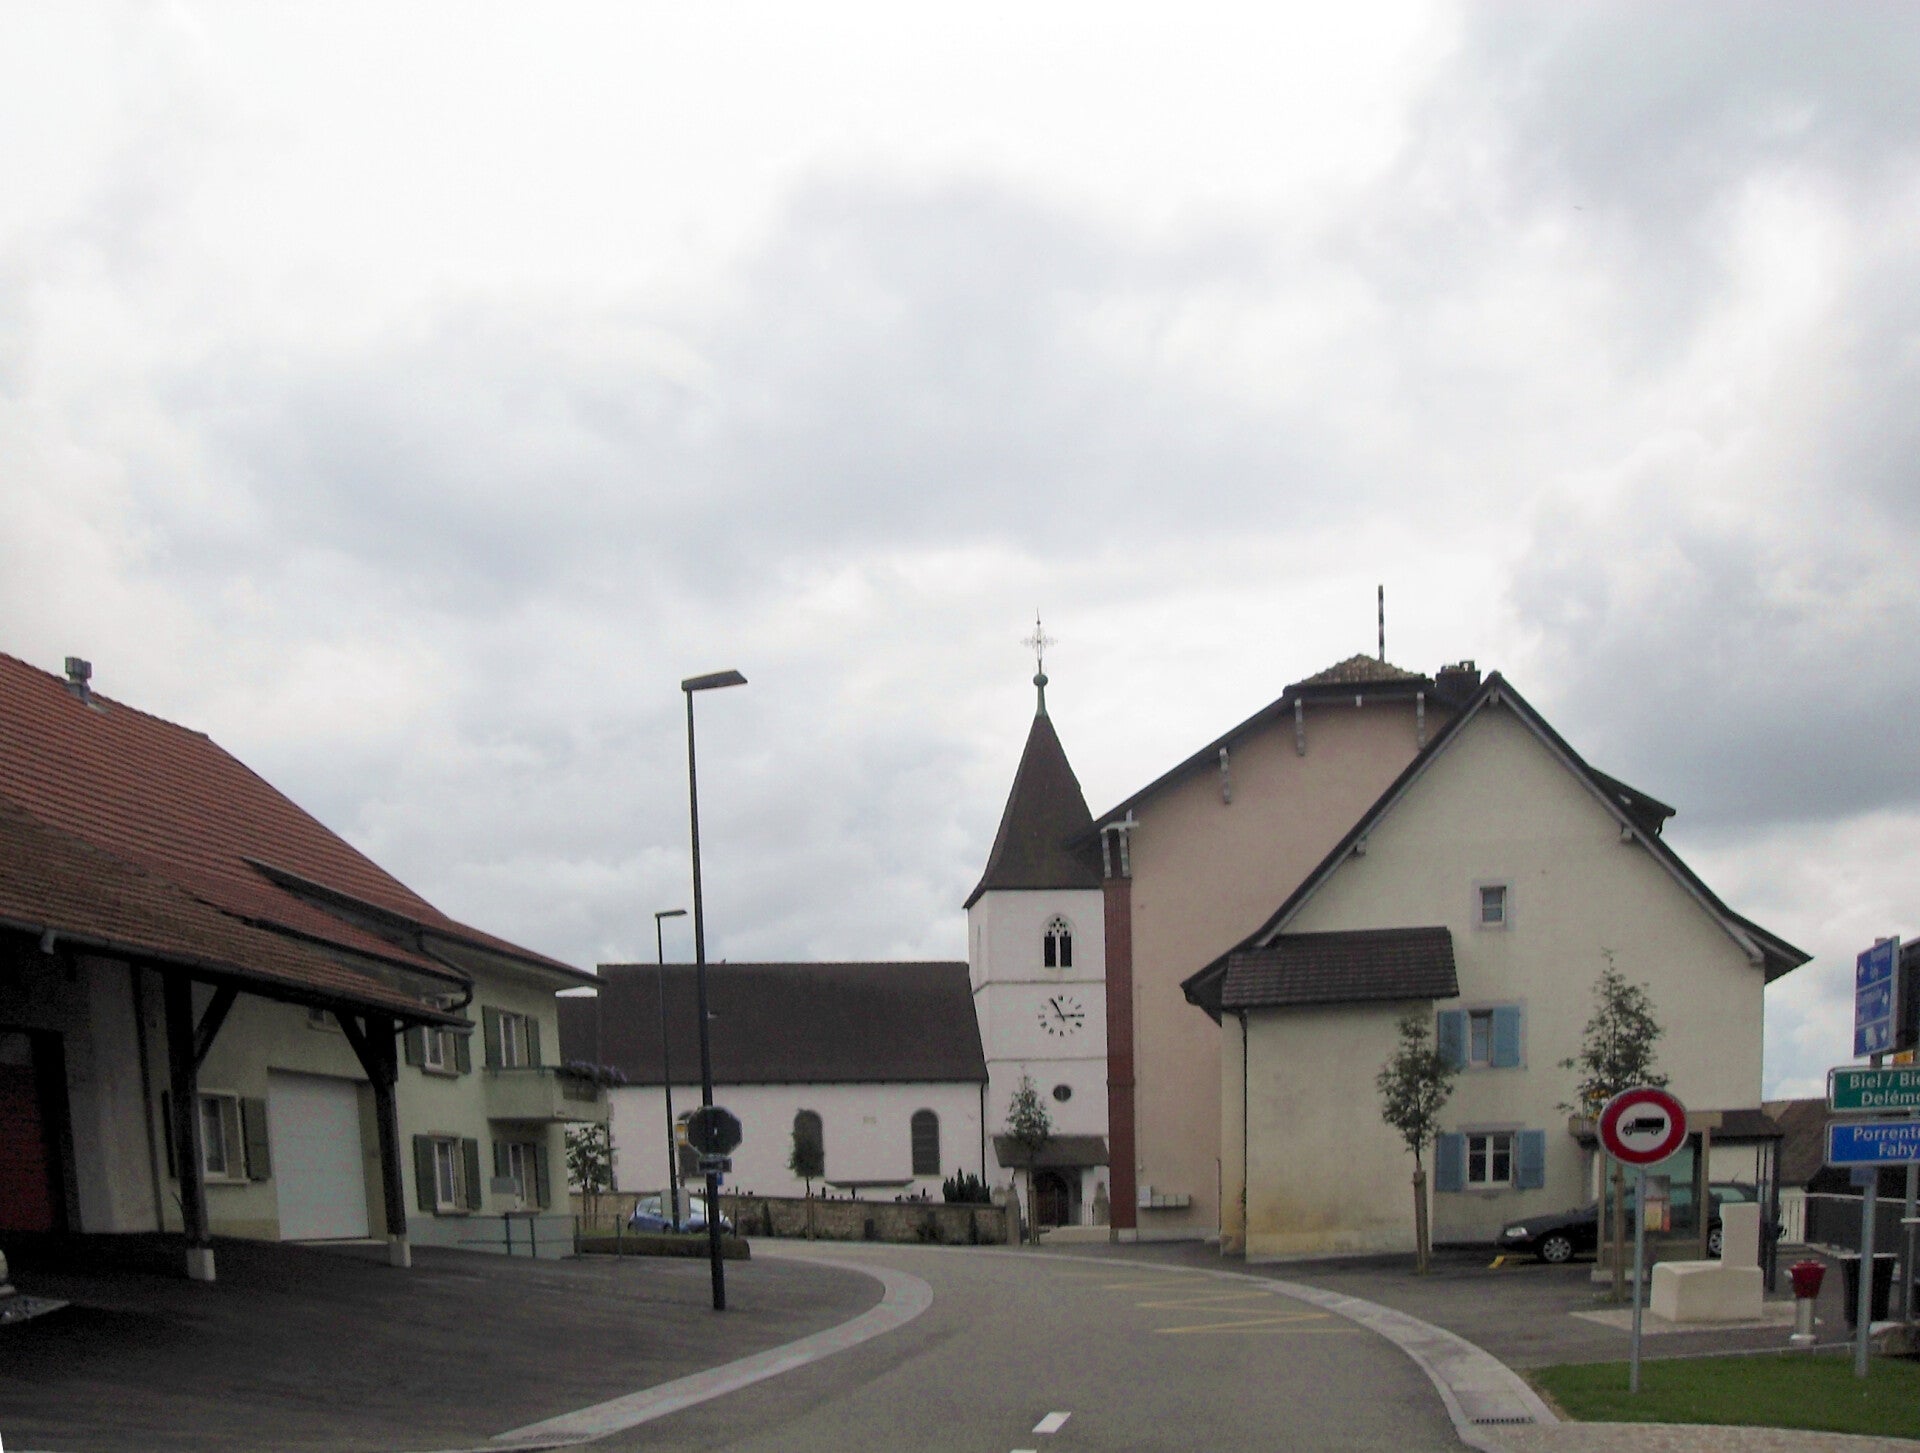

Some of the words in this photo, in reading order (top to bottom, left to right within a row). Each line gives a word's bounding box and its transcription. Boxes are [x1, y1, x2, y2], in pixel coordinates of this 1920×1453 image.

[1850, 1073, 1881, 1089] Biel
[1887, 1072, 1894, 1087] /
[1879, 1140, 1918, 1160] Fahy
